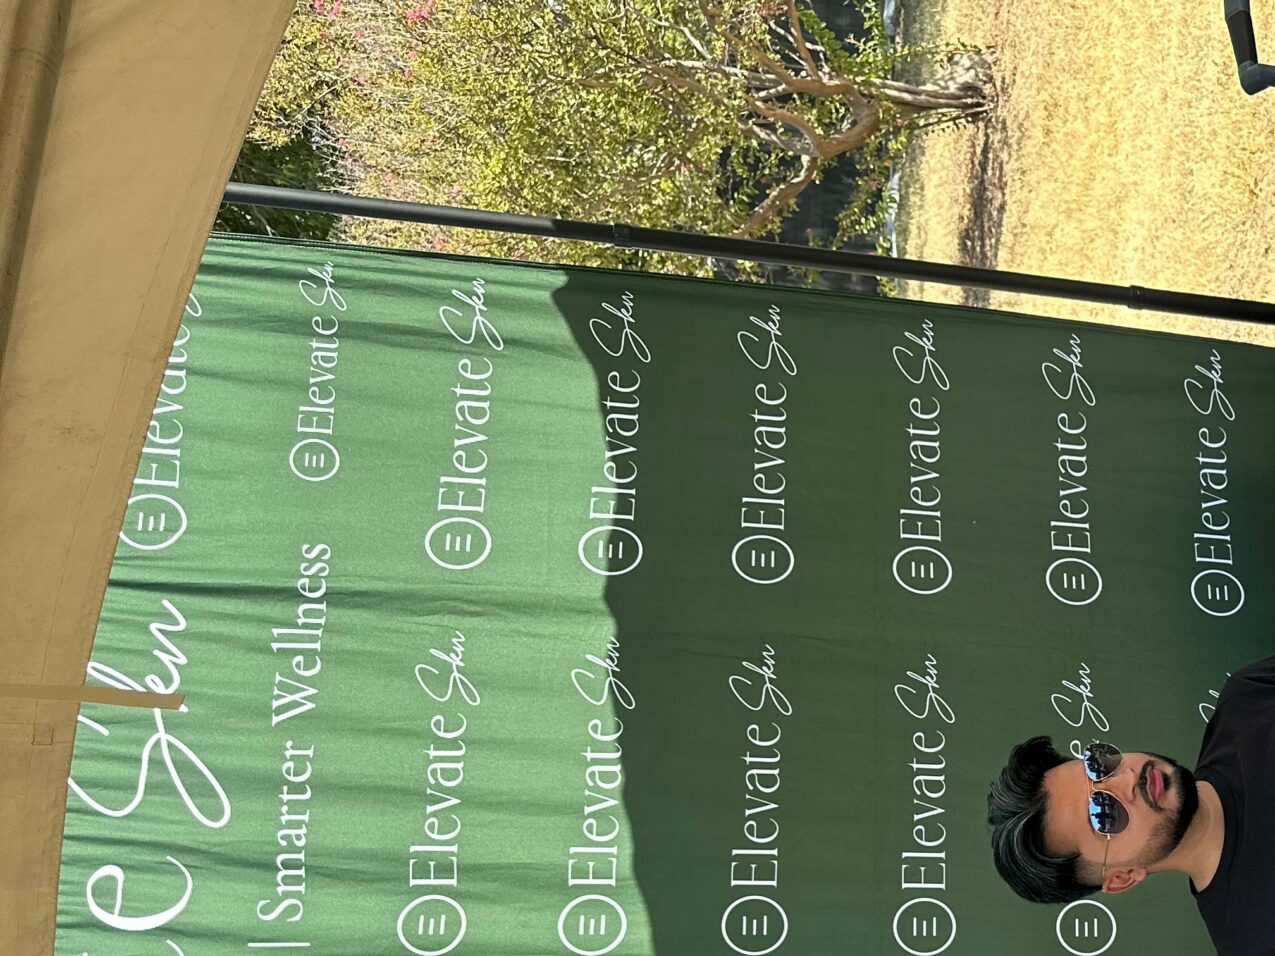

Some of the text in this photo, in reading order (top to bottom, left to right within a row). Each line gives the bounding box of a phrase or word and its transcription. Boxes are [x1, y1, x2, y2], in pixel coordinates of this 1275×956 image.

[297, 316, 340, 435] Elevate
[438, 358, 493, 513] Elevate
[589, 370, 640, 521] Elevate
[741, 382, 787, 530] Elevate
[900, 397, 941, 542] Elevate
[1051, 412, 1091, 553] Elevate
[1194, 427, 1233, 565] Elevate
[271, 544, 331, 726] Wellness
[257, 740, 314, 921] Smarter
[409, 713, 467, 887] Elevate
[567, 717, 624, 887] Elevate
[730, 723, 781, 888] Elevate
[902, 730, 946, 890] Elevate
